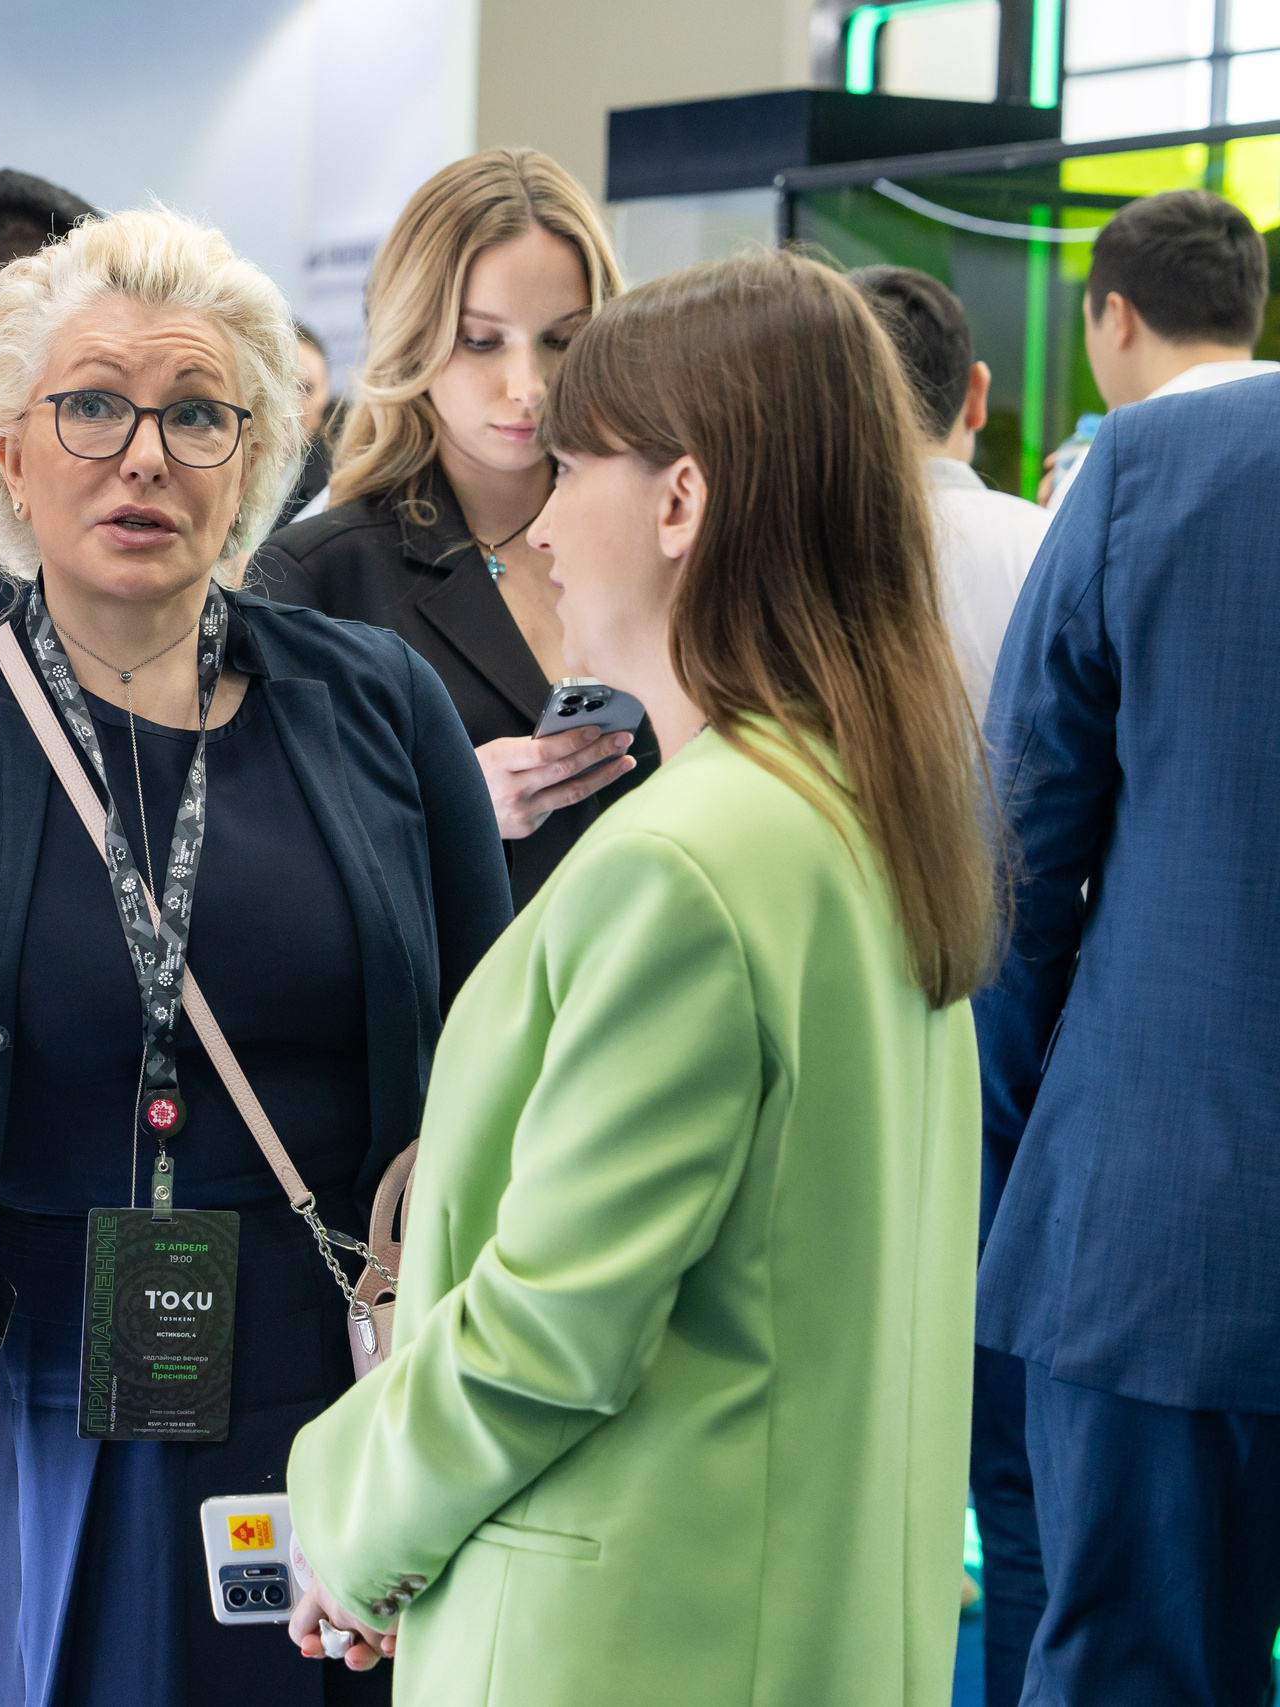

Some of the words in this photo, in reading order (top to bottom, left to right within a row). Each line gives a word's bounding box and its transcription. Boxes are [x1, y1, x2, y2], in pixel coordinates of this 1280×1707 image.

[155, 1243, 166, 1251] 23
[168, 1243, 209, 1252] АПРЕЛЯ
[170, 1254, 193, 1263] 19:00
[145, 1290, 213, 1311] TOKU
[87, 1216, 118, 1432] ПРИГЛАШЕНИЕ
[142, 1354, 182, 1362] хедлайнер
[182, 1355, 209, 1363] вечера
[153, 1362, 197, 1372] Владимир
[151, 1372, 198, 1381] Пресняков
[255, 1518, 265, 1546] BEAUTY
[262, 1521, 270, 1543] INSIDE
